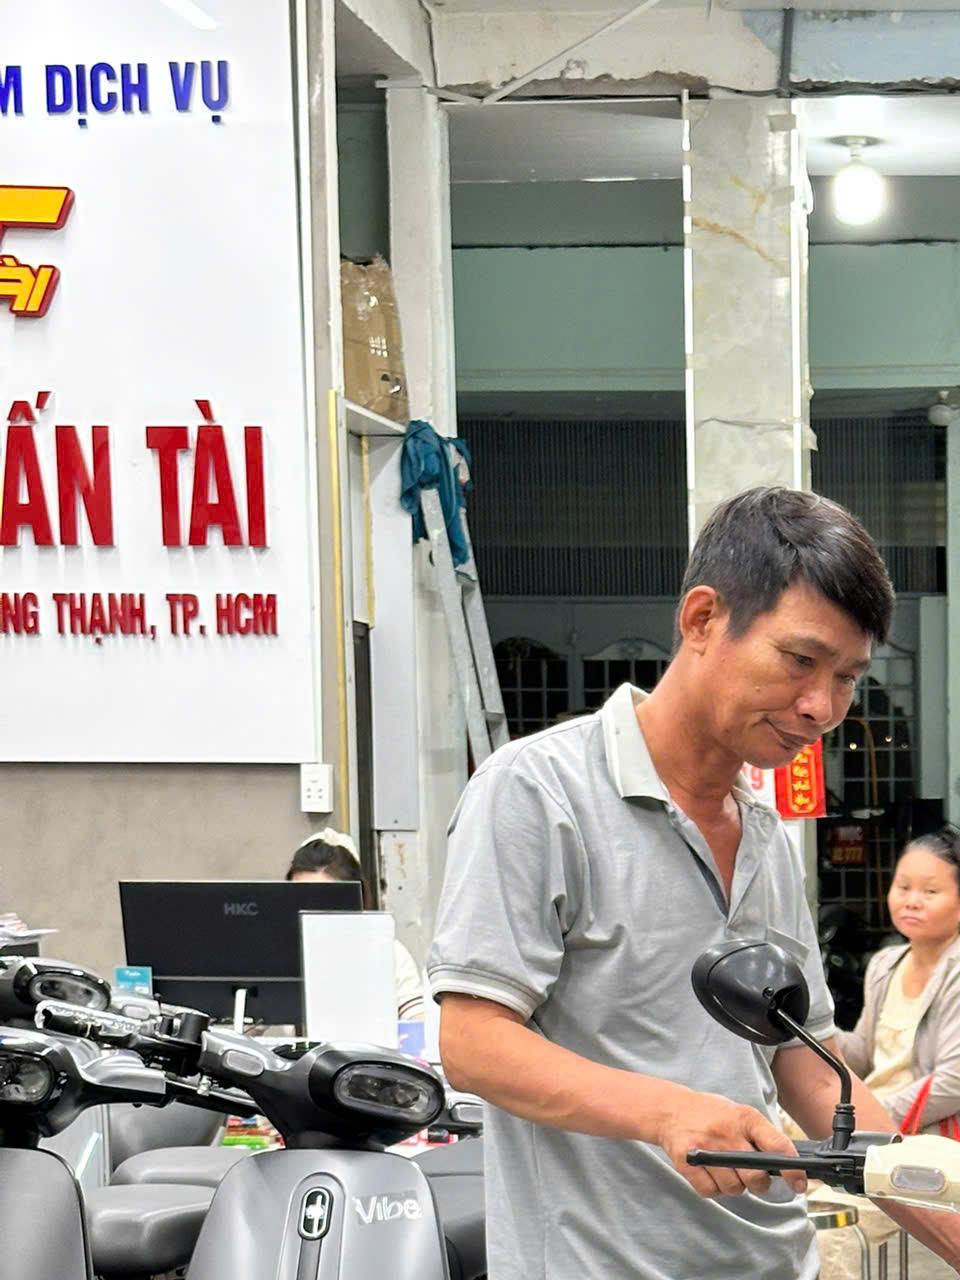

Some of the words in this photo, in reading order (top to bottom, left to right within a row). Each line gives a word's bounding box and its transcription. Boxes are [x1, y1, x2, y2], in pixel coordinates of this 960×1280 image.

[45, 62, 149, 127] DỊCH
[169, 61, 229, 123] VỤ
[0, 391, 114, 547] ẤN
[146, 399, 267, 548] TÀI
[53, 593, 156, 645] THẠNH,
[166, 593, 206, 636] TP.
[216, 593, 278, 636] HCM
[223, 902, 259, 916] HKC
[352, 1195, 423, 1225] Vibe
